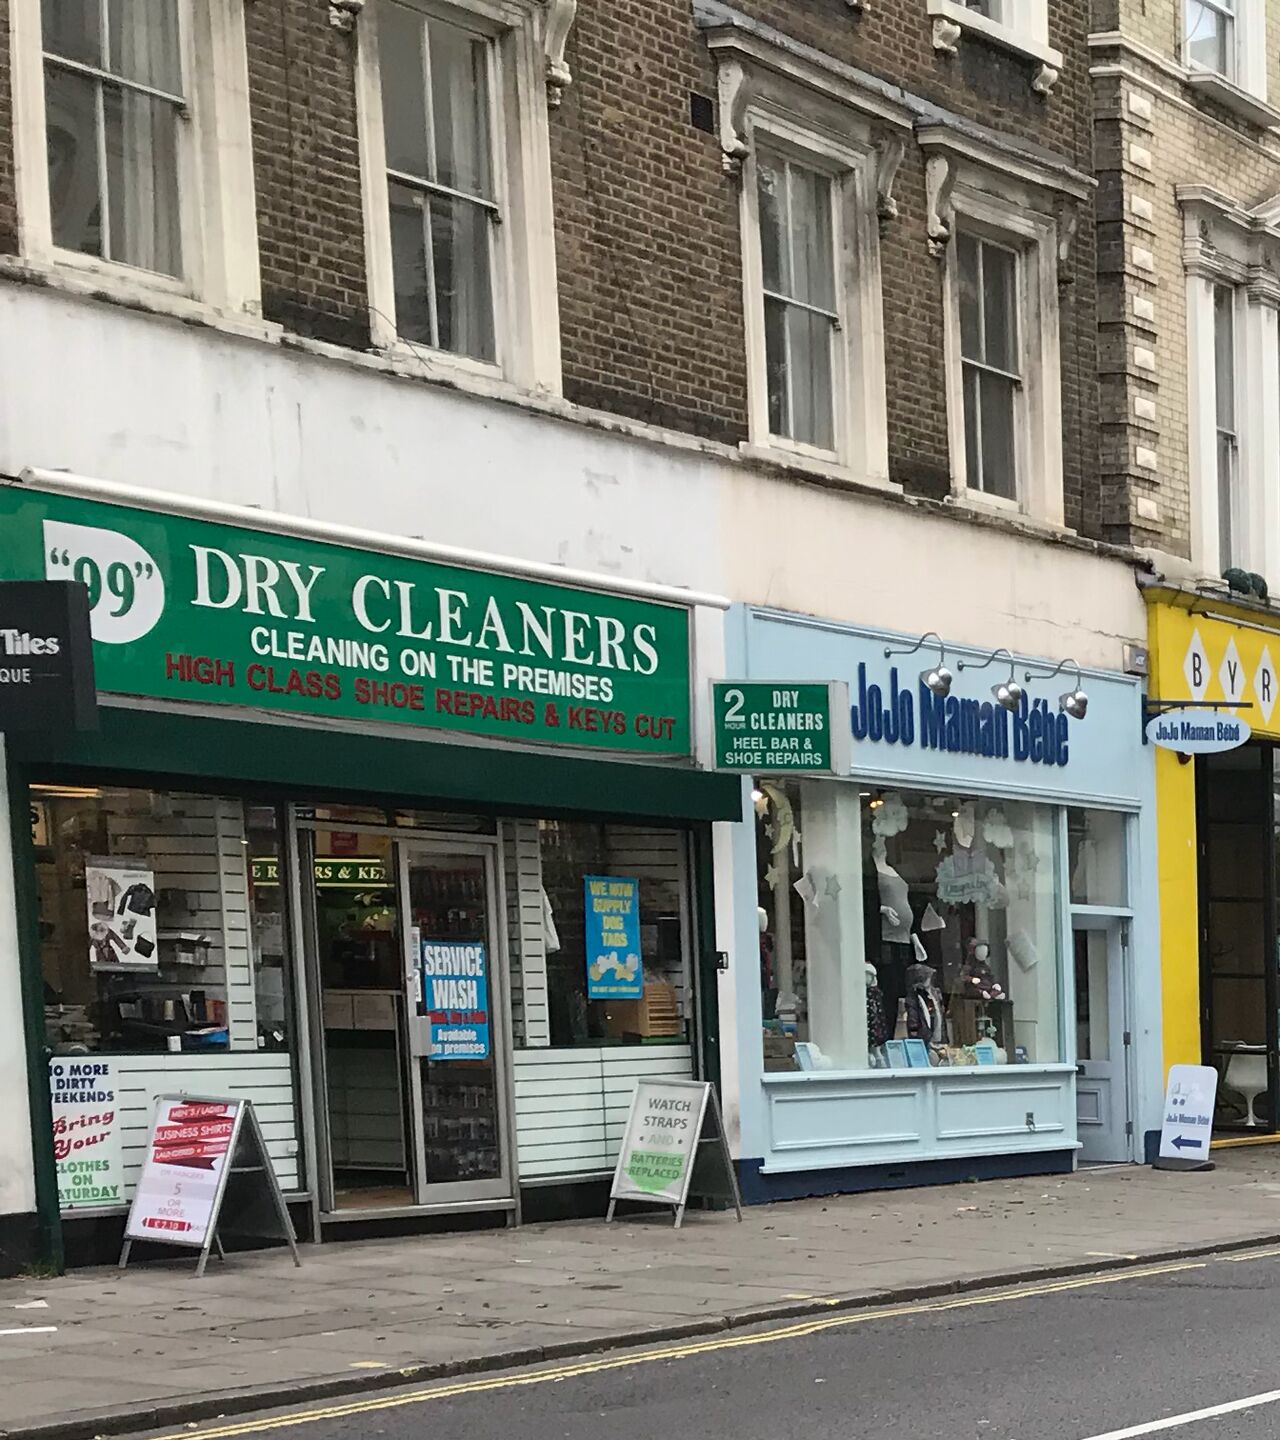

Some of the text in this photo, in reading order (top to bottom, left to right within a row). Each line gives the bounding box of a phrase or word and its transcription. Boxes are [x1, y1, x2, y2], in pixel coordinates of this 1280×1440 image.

[188, 544, 659, 676] DRY CLEANERS
[0, 629, 60, 655] Tiles
[251, 626, 614, 703] CLEANING ON THE PREMISES
[165, 652, 676, 741] HIGH CLASS SHOE REPAIRS & KEYS CUT
[724, 689, 799, 721] 2 DRY
[851, 662, 915, 746] JoJo
[919, 676, 1009, 760] Maman
[724, 713, 823, 730] HOUR CLEANERS
[1156, 722, 1239, 741] JoJo Maman Bébé
[733, 737, 812, 750] HEEL BAR &
[725, 752, 822, 765] SHOE REPAIRS
[424, 945, 484, 976] SERVICE
[432, 979, 478, 1009] WASH
[69, 1064, 109, 1076] MORE
[56, 1077, 96, 1090] DIRTY
[51, 1091, 114, 1103] EEKENDS
[648, 1098, 692, 1112] WATCH
[52, 1111, 114, 1137] Bring
[643, 1116, 689, 1129] STRAPS
[53, 1131, 112, 1160] Your
[630, 1154, 683, 1167] BATTERIES
[71, 1174, 93, 1187] ON
[628, 1166, 680, 1180] REPLACED
[58, 1185, 119, 1200] ATURDAY
[173, 1183, 182, 1195] 5
